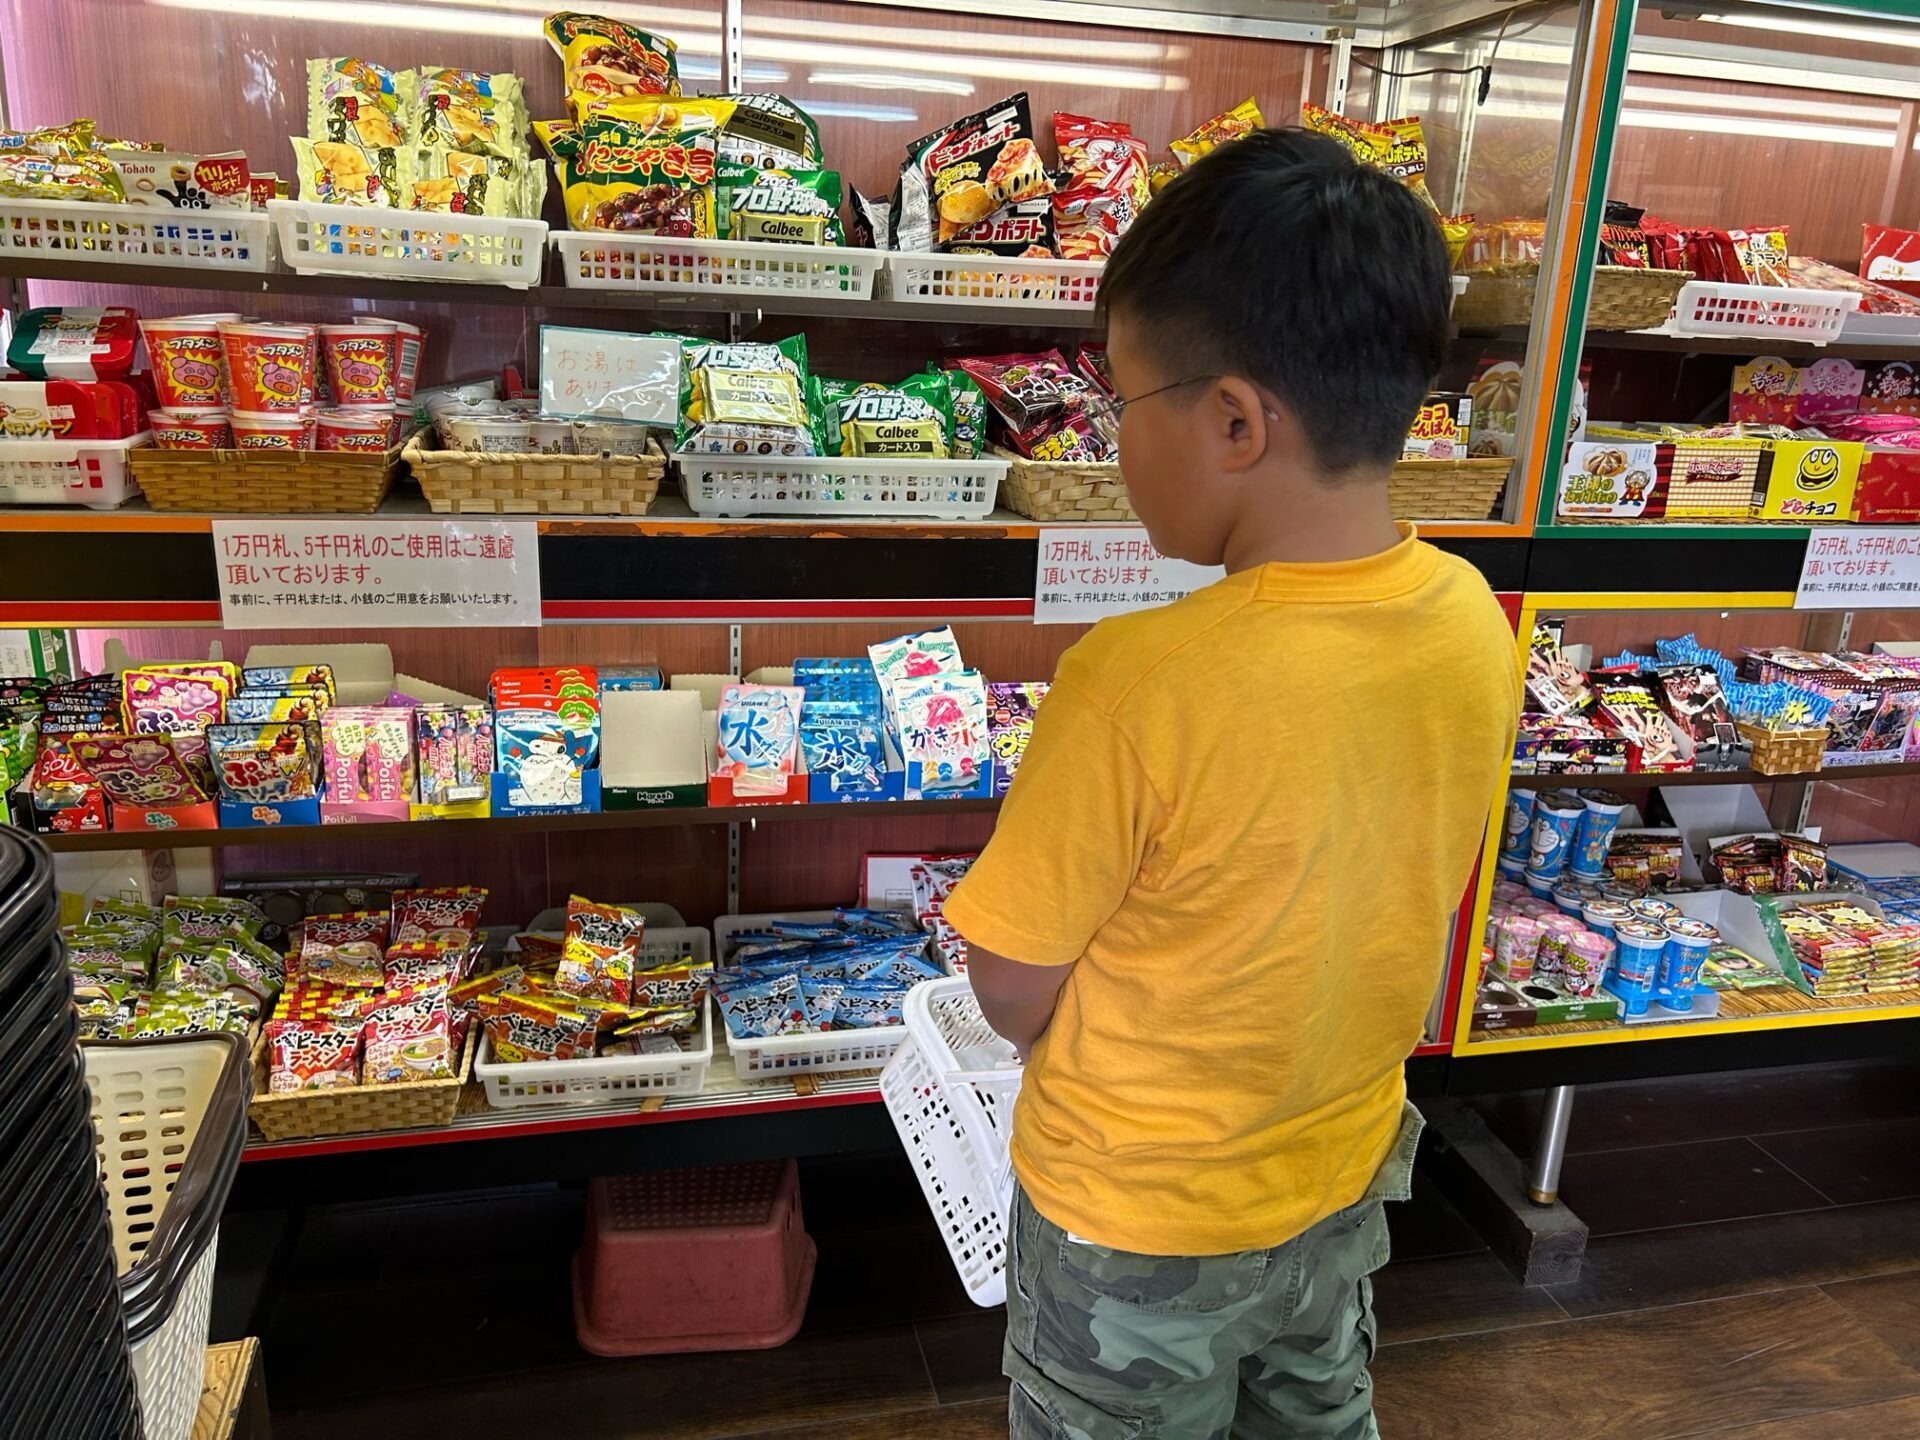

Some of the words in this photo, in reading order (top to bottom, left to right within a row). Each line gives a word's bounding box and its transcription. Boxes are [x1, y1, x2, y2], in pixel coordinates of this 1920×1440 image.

[744, 108, 785, 128] Calbee
[953, 121, 985, 142] Calbee
[928, 122, 1022, 175] ピザポテト
[119, 163, 156, 175] Tohato
[576, 141, 716, 185] たこやき亭
[717, 166, 746, 178] Calbee
[1388, 163, 1424, 177] Qあじ
[195, 163, 240, 182] カリッと
[759, 175, 799, 188] 2023
[731, 186, 817, 215] プロ野球
[761, 220, 804, 237] Calbee
[168, 337, 218, 350] ブタメン
[262, 344, 304, 356] ブタメン
[337, 340, 381, 352] ブタメン
[558, 350, 636, 375] お湯は
[838, 396, 929, 421] プロ野球
[876, 425, 919, 439] Calbee
[878, 443, 921, 453] カード入り
[1779, 498, 1838, 516] どらチョコ
[221, 534, 515, 560] 1万円札、5千円札のご使用はご遠慮
[225, 563, 382, 585] 頂いております。
[1043, 566, 1159, 585] 頂いております。
[1806, 560, 1895, 576] 頂いております。
[229, 593, 518, 607] 事前に、千円札または、小銭のご用意をお願いいたします。
[726, 708, 769, 757] 水
[910, 718, 979, 750] かき氷
[222, 761, 282, 787] ぷちっと
[410, 897, 480, 912] ベビースター
[166, 911, 246, 926] ベビースター
[414, 910, 464, 923] ラーメン
[571, 912, 640, 938] ベビースター
[179, 923, 224, 938] うどん
[316, 929, 370, 942] ラーメン
[72, 951, 124, 965] うどん
[636, 978, 708, 995] ベビースター
[727, 991, 798, 1015] ベビースター
[378, 1016, 432, 1038] ラーメン
[500, 1013, 574, 1044] ベビースター
[275, 1031, 357, 1049] ベビースター
[289, 1049, 342, 1067] ラーメン
